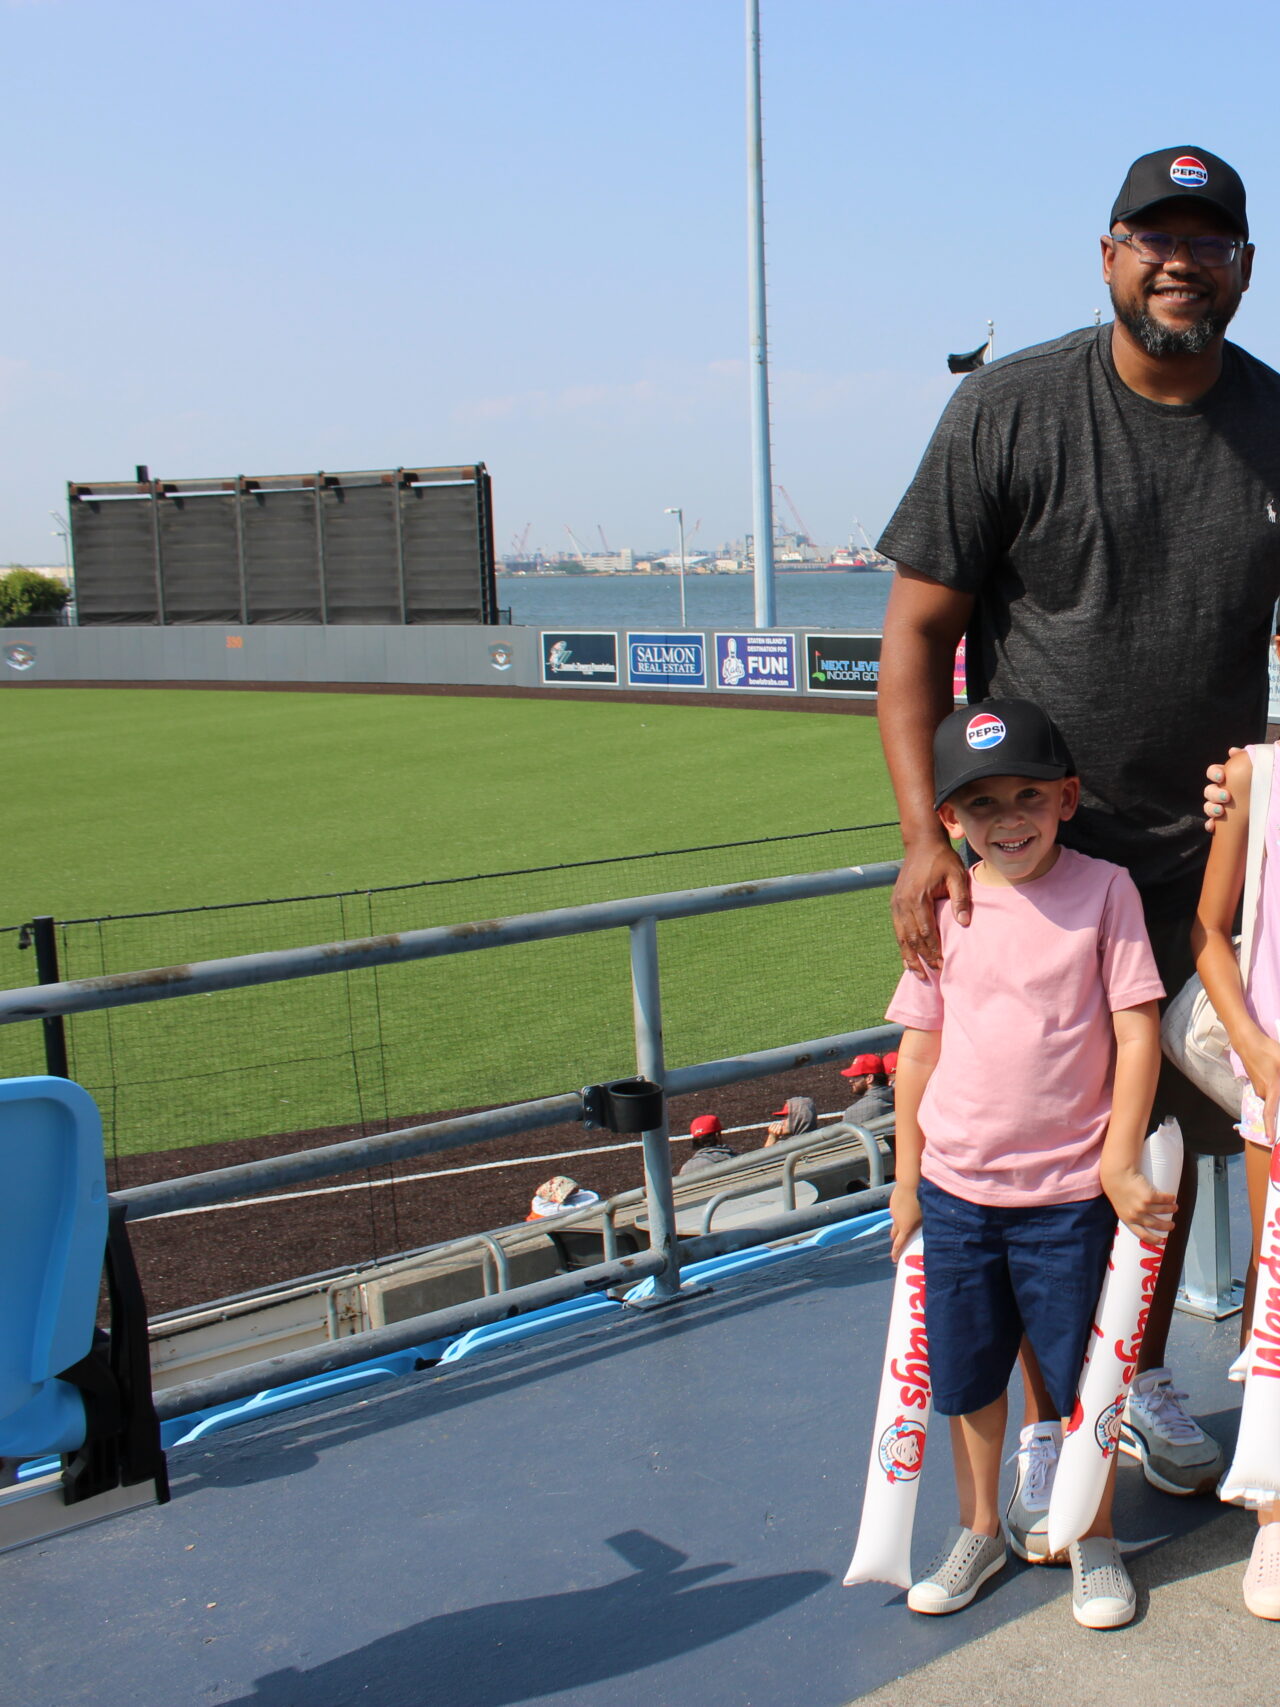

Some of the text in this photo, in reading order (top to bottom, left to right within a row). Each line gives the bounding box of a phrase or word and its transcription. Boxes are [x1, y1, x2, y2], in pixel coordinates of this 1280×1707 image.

[1172, 168, 1207, 180] PEPSI
[637, 646, 696, 663] SALMON
[637, 662, 696, 673] REAL ESTATE
[748, 656, 789, 675] FUN!
[821, 660, 880, 672] NEXT LEVE
[827, 671, 880, 681] INDOOR GOL
[968, 725, 1005, 740] PEPSI
